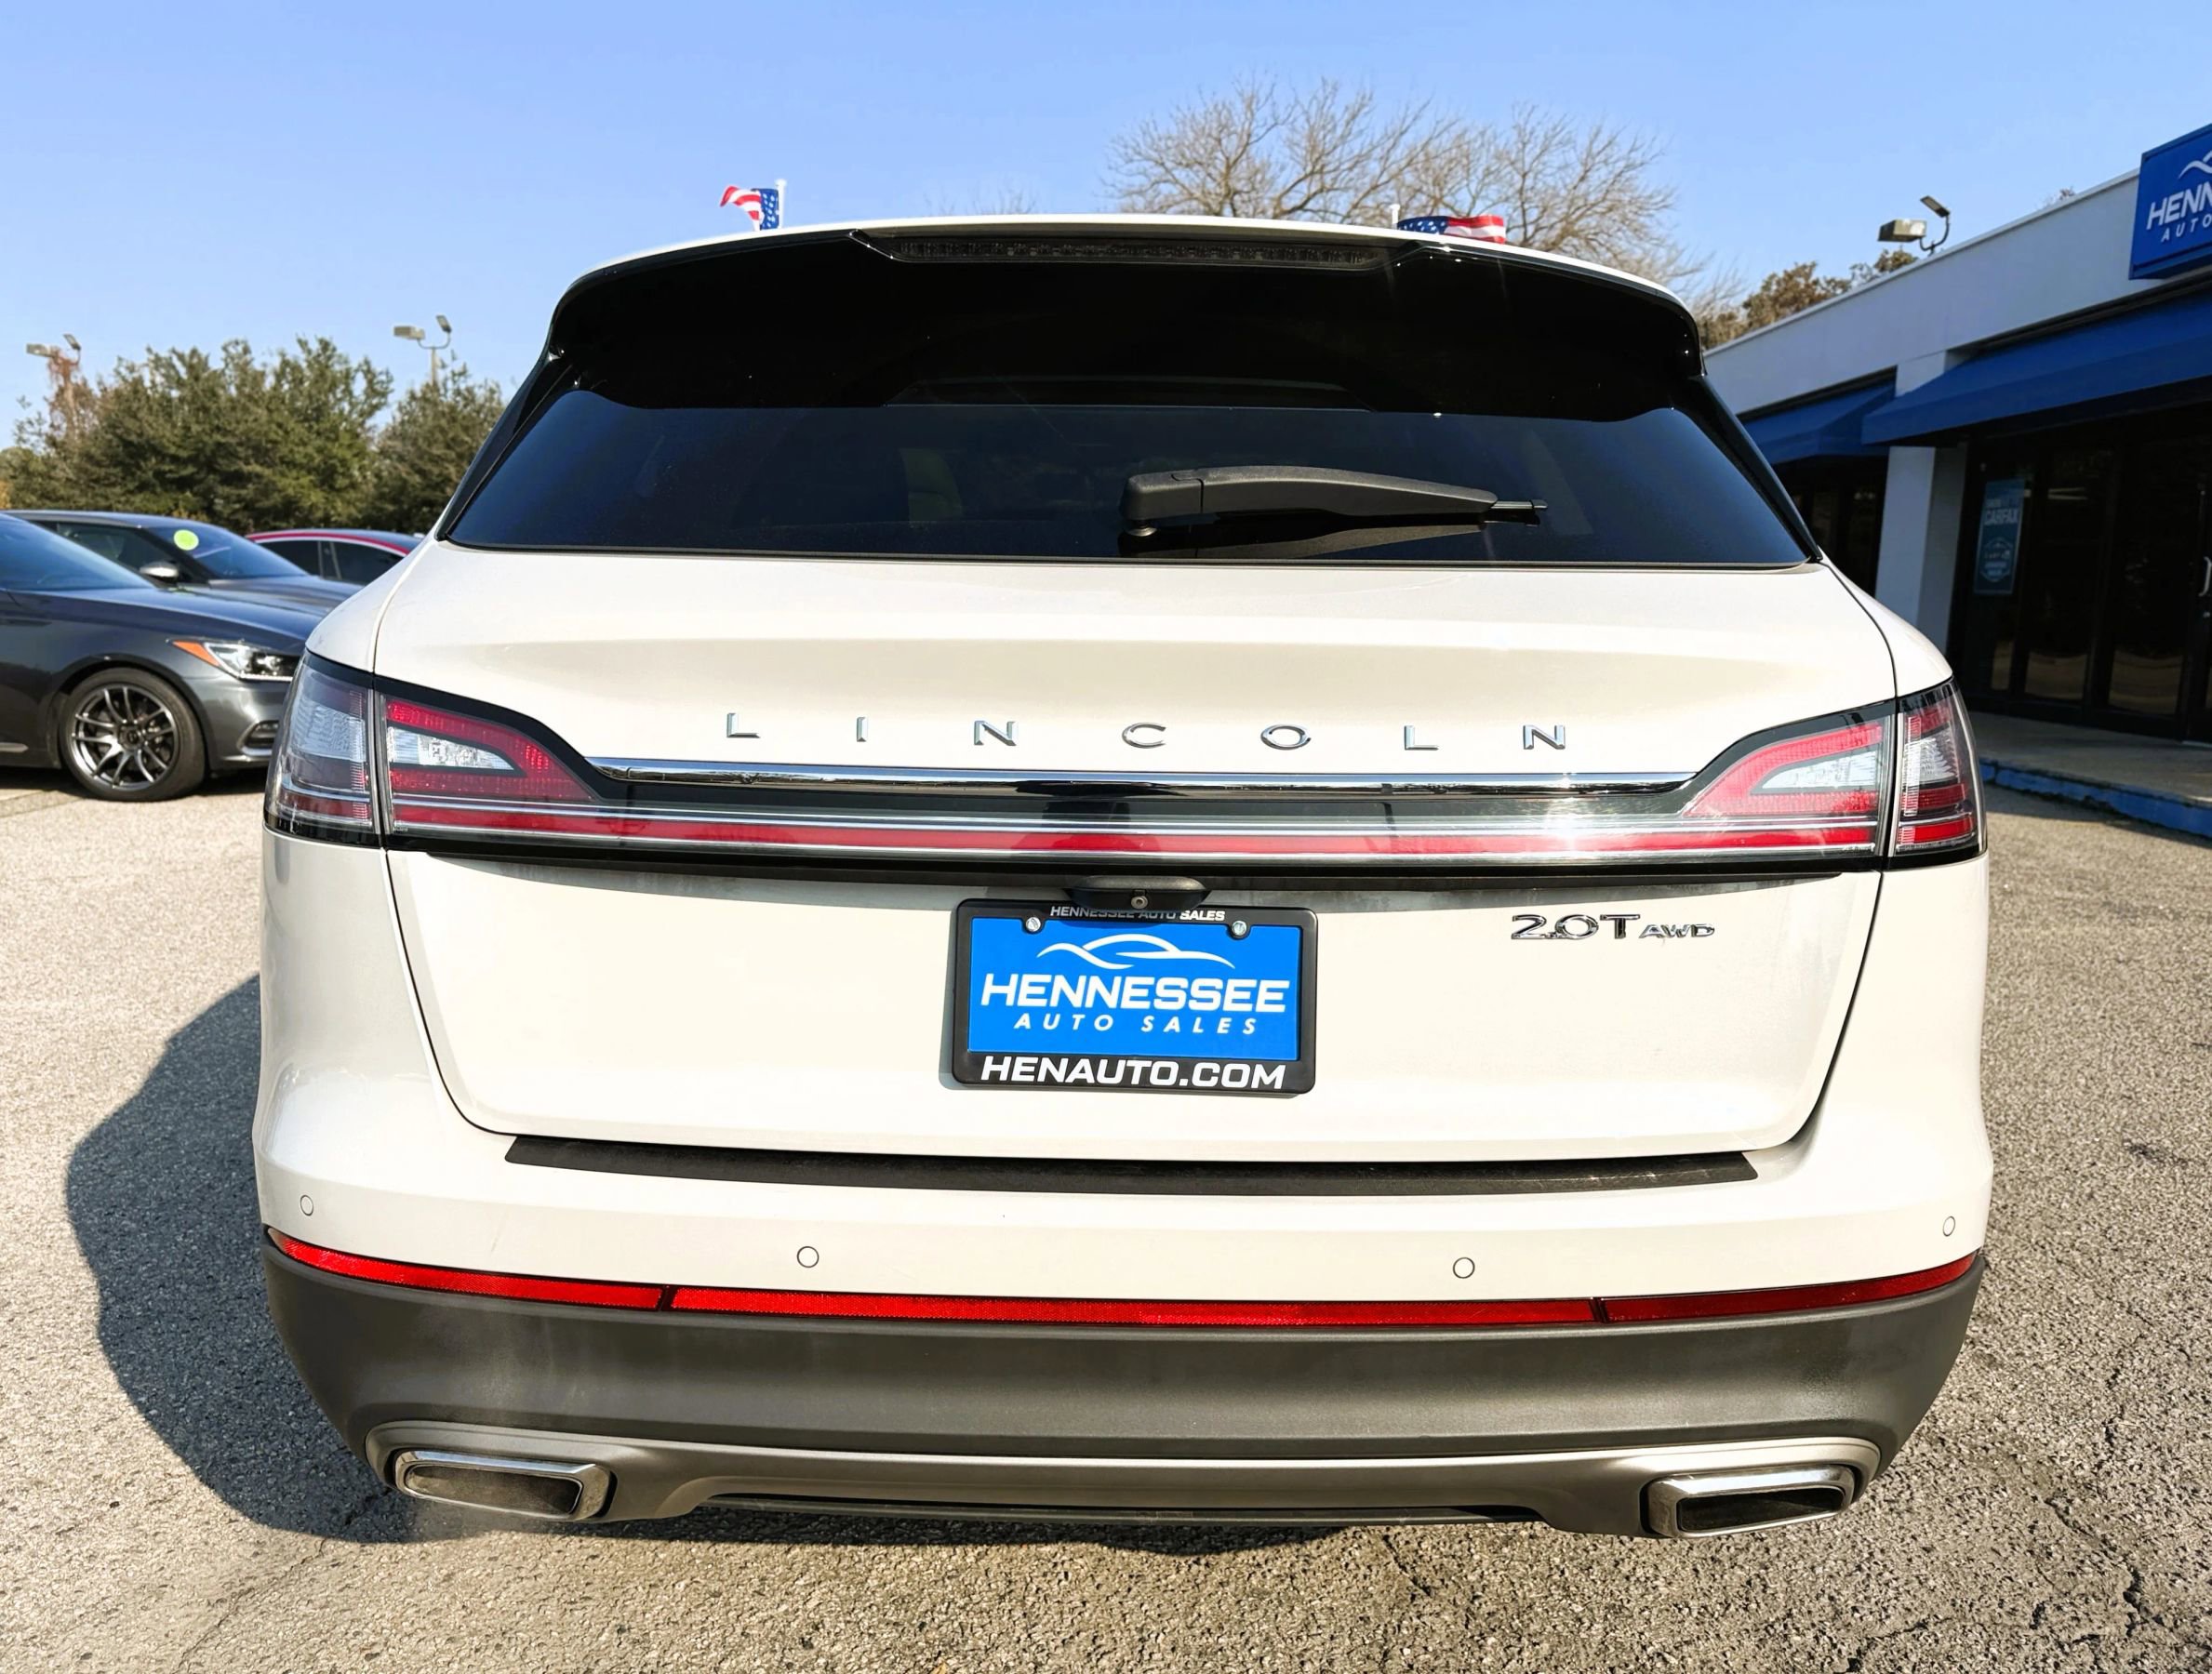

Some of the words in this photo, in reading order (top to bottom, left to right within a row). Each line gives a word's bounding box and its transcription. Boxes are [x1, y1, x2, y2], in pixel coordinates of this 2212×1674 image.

[2161, 213, 2212, 242] AUTO
[726, 712, 1566, 751] LINCOLN
[1179, 910, 1226, 921] SALES
[1638, 923, 1715, 939] AWD
[980, 973, 1290, 1013] HENNESSEE
[1014, 1014, 1113, 1031] AUTO
[1141, 1016, 1257, 1034] SALES
[980, 1056, 1286, 1089] HENAUTO.COM
